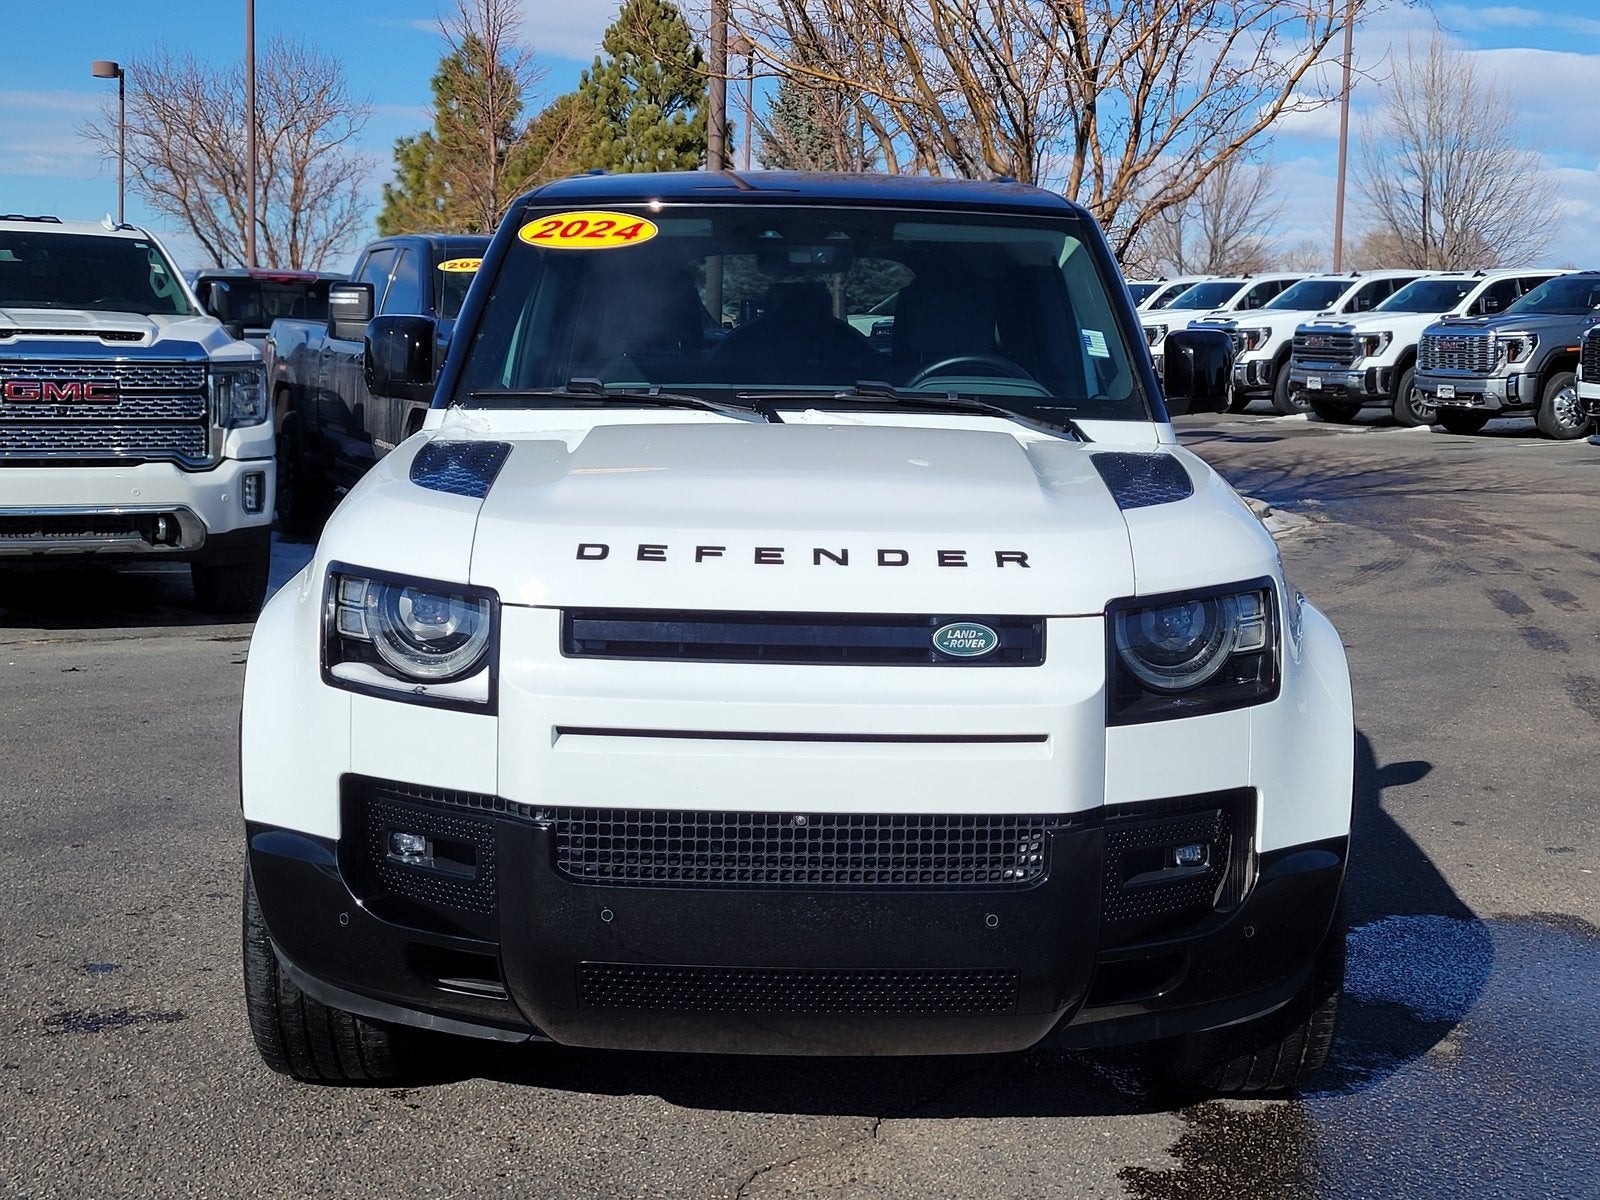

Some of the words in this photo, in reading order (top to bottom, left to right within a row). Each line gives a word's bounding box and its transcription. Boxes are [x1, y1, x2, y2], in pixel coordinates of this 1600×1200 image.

[530, 220, 646, 241] 2024
[447, 261, 481, 269] 202
[4, 381, 118, 401] GMC
[576, 543, 1031, 569] DEFENDER
[947, 629, 977, 639] LAND
[949, 639, 986, 648] ROVER
